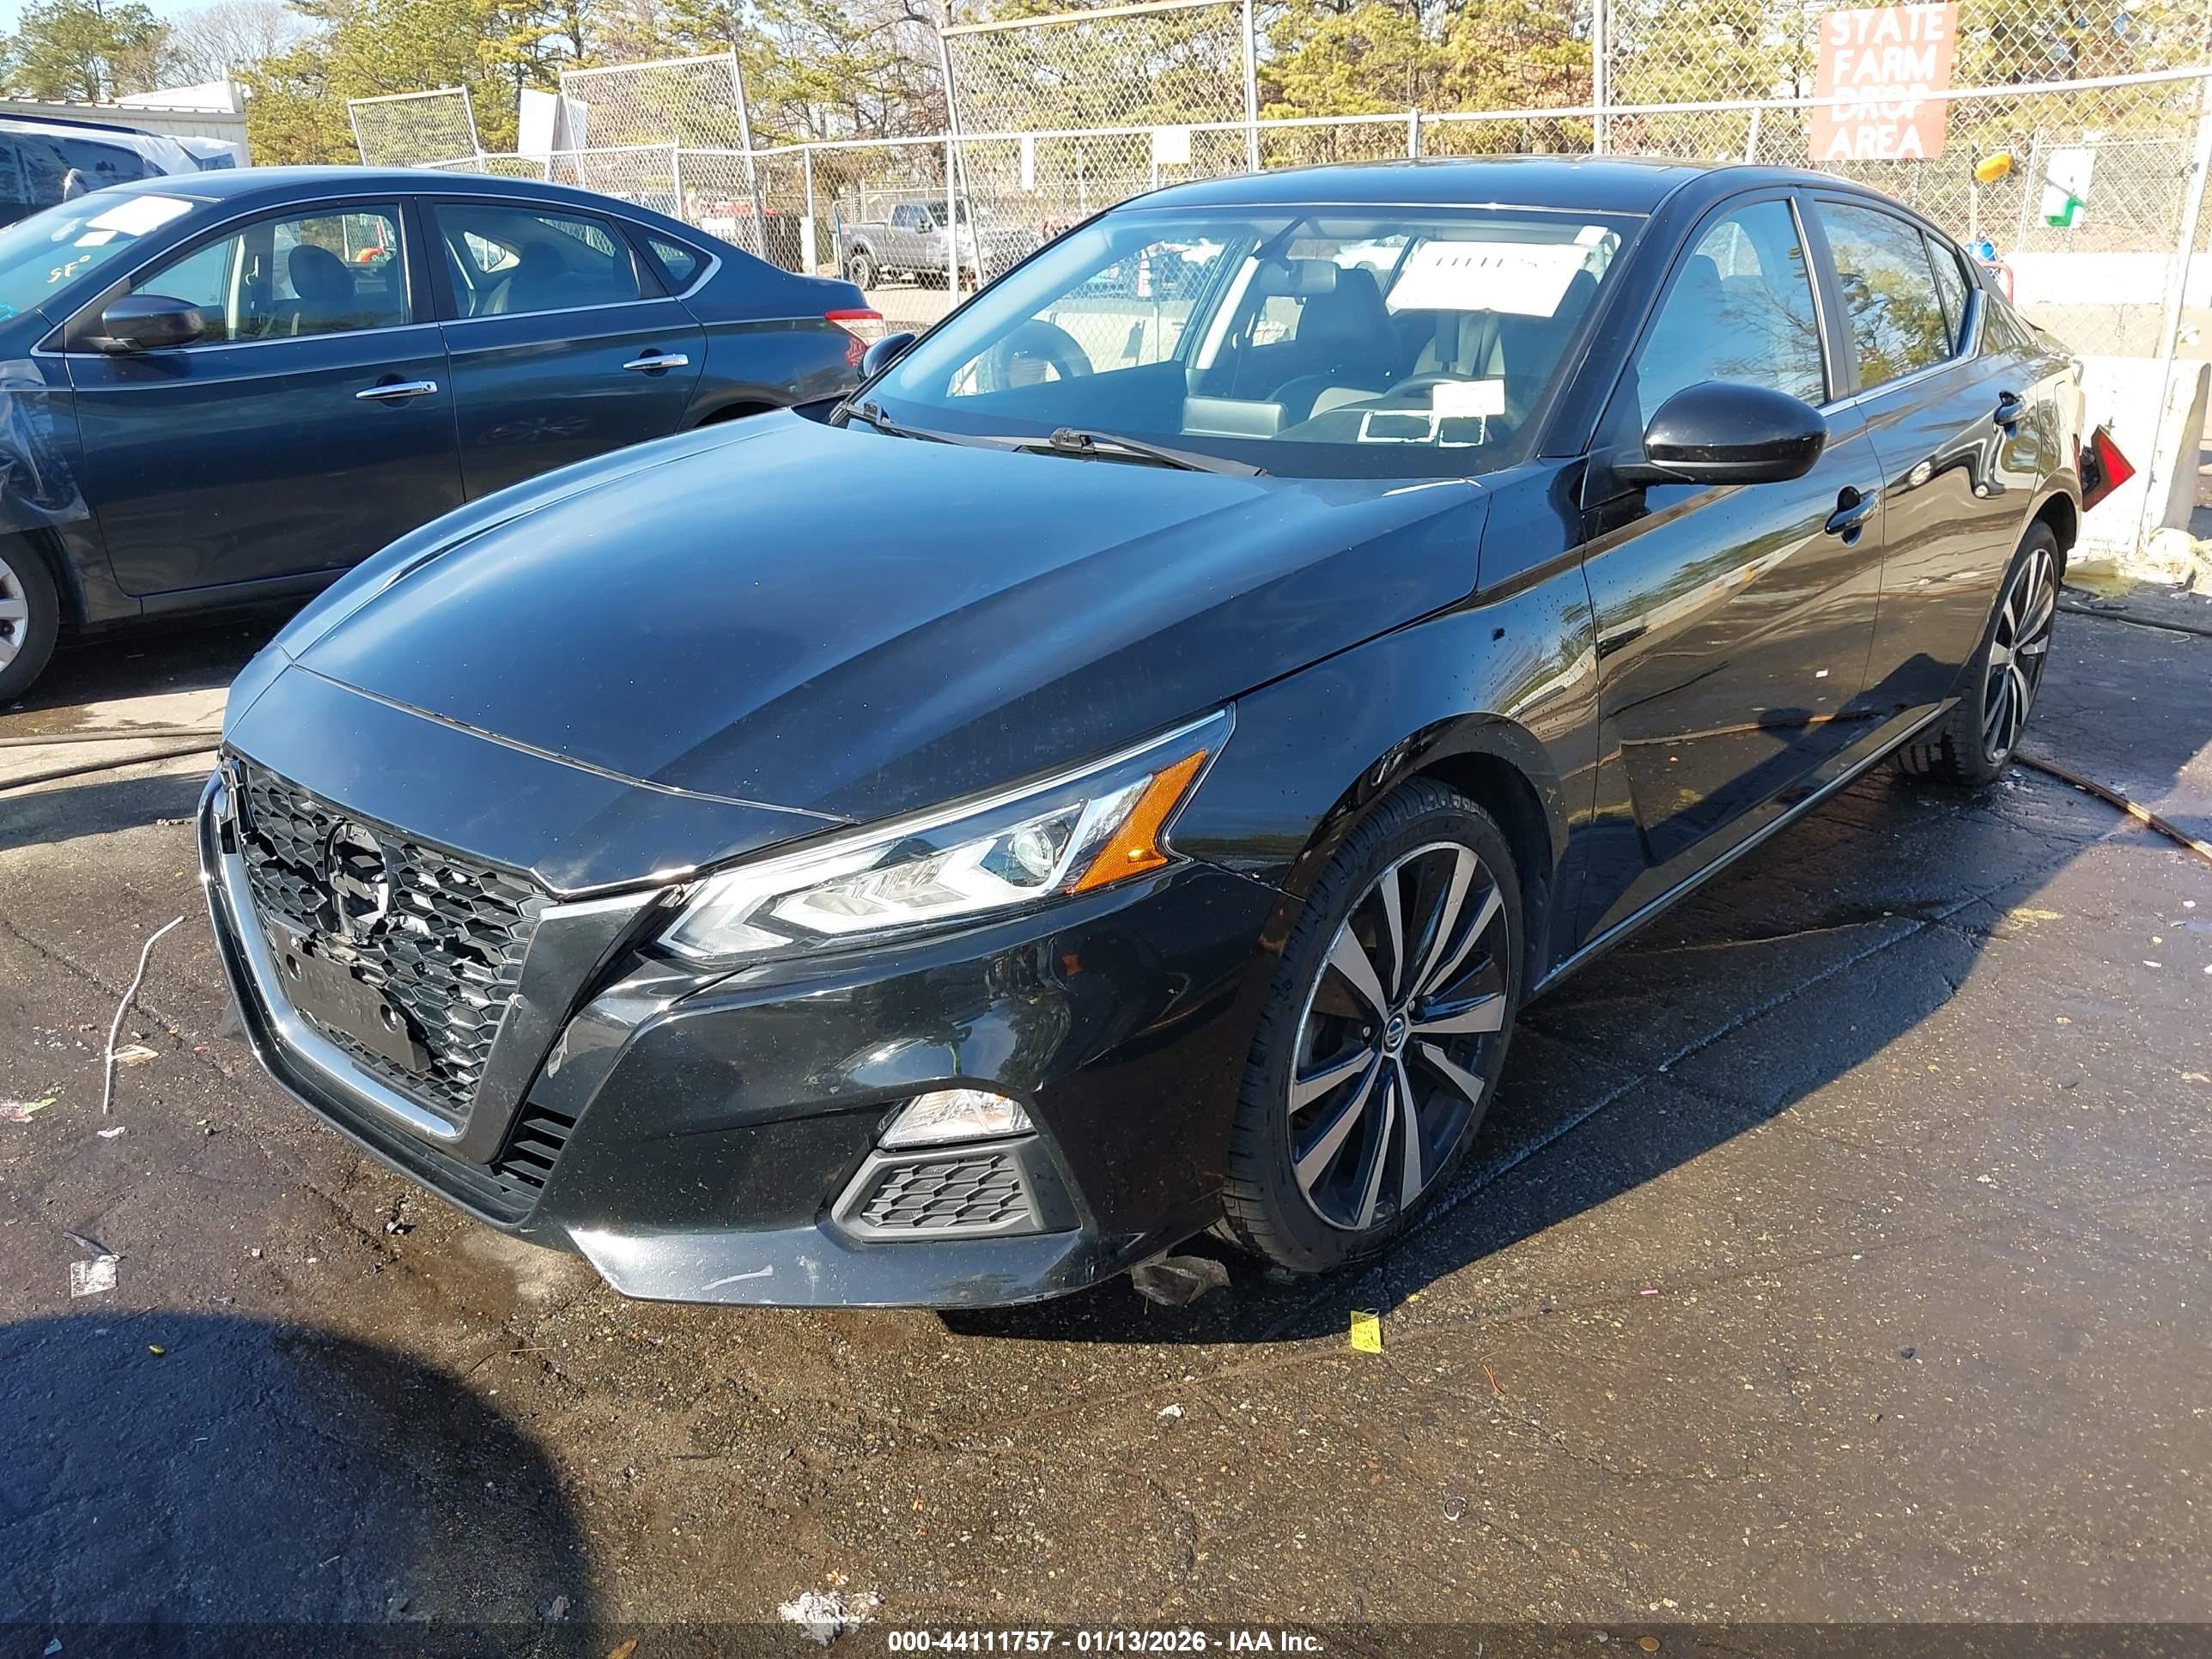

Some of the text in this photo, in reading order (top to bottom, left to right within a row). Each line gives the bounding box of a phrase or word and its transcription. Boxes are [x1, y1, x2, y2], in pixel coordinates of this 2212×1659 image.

[1830, 3, 1947, 46] STATE
[1832, 44, 1937, 85] FARM
[1831, 82, 1929, 122] DROP
[1825, 124, 1924, 161] AREA
